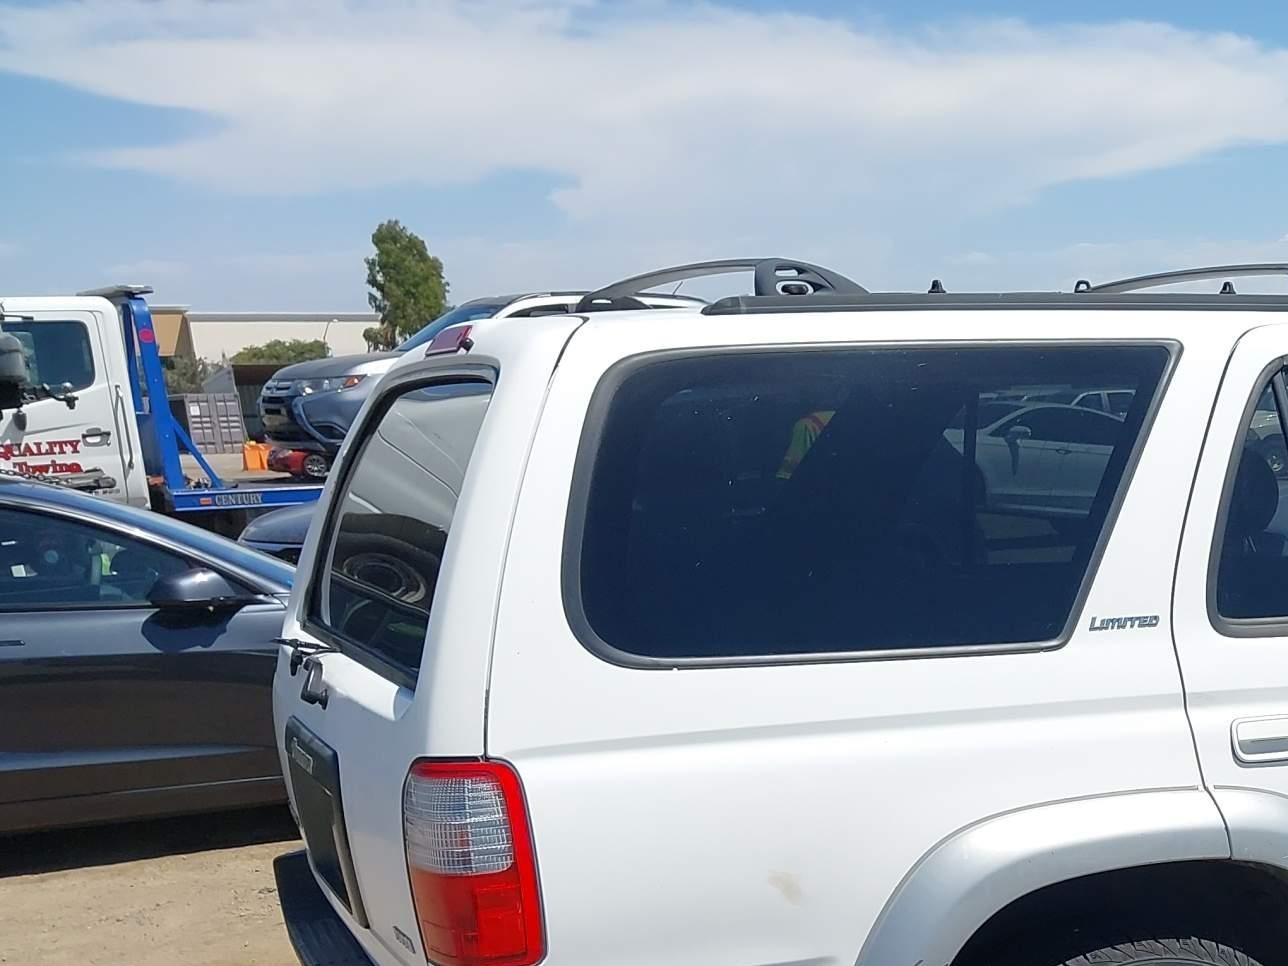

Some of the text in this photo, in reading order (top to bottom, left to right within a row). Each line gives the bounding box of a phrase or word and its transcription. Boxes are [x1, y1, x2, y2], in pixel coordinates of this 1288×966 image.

[0, 439, 81, 460] QUALITY
[215, 492, 263, 506] CENTURY
[1089, 615, 1160, 632] LIMITED
